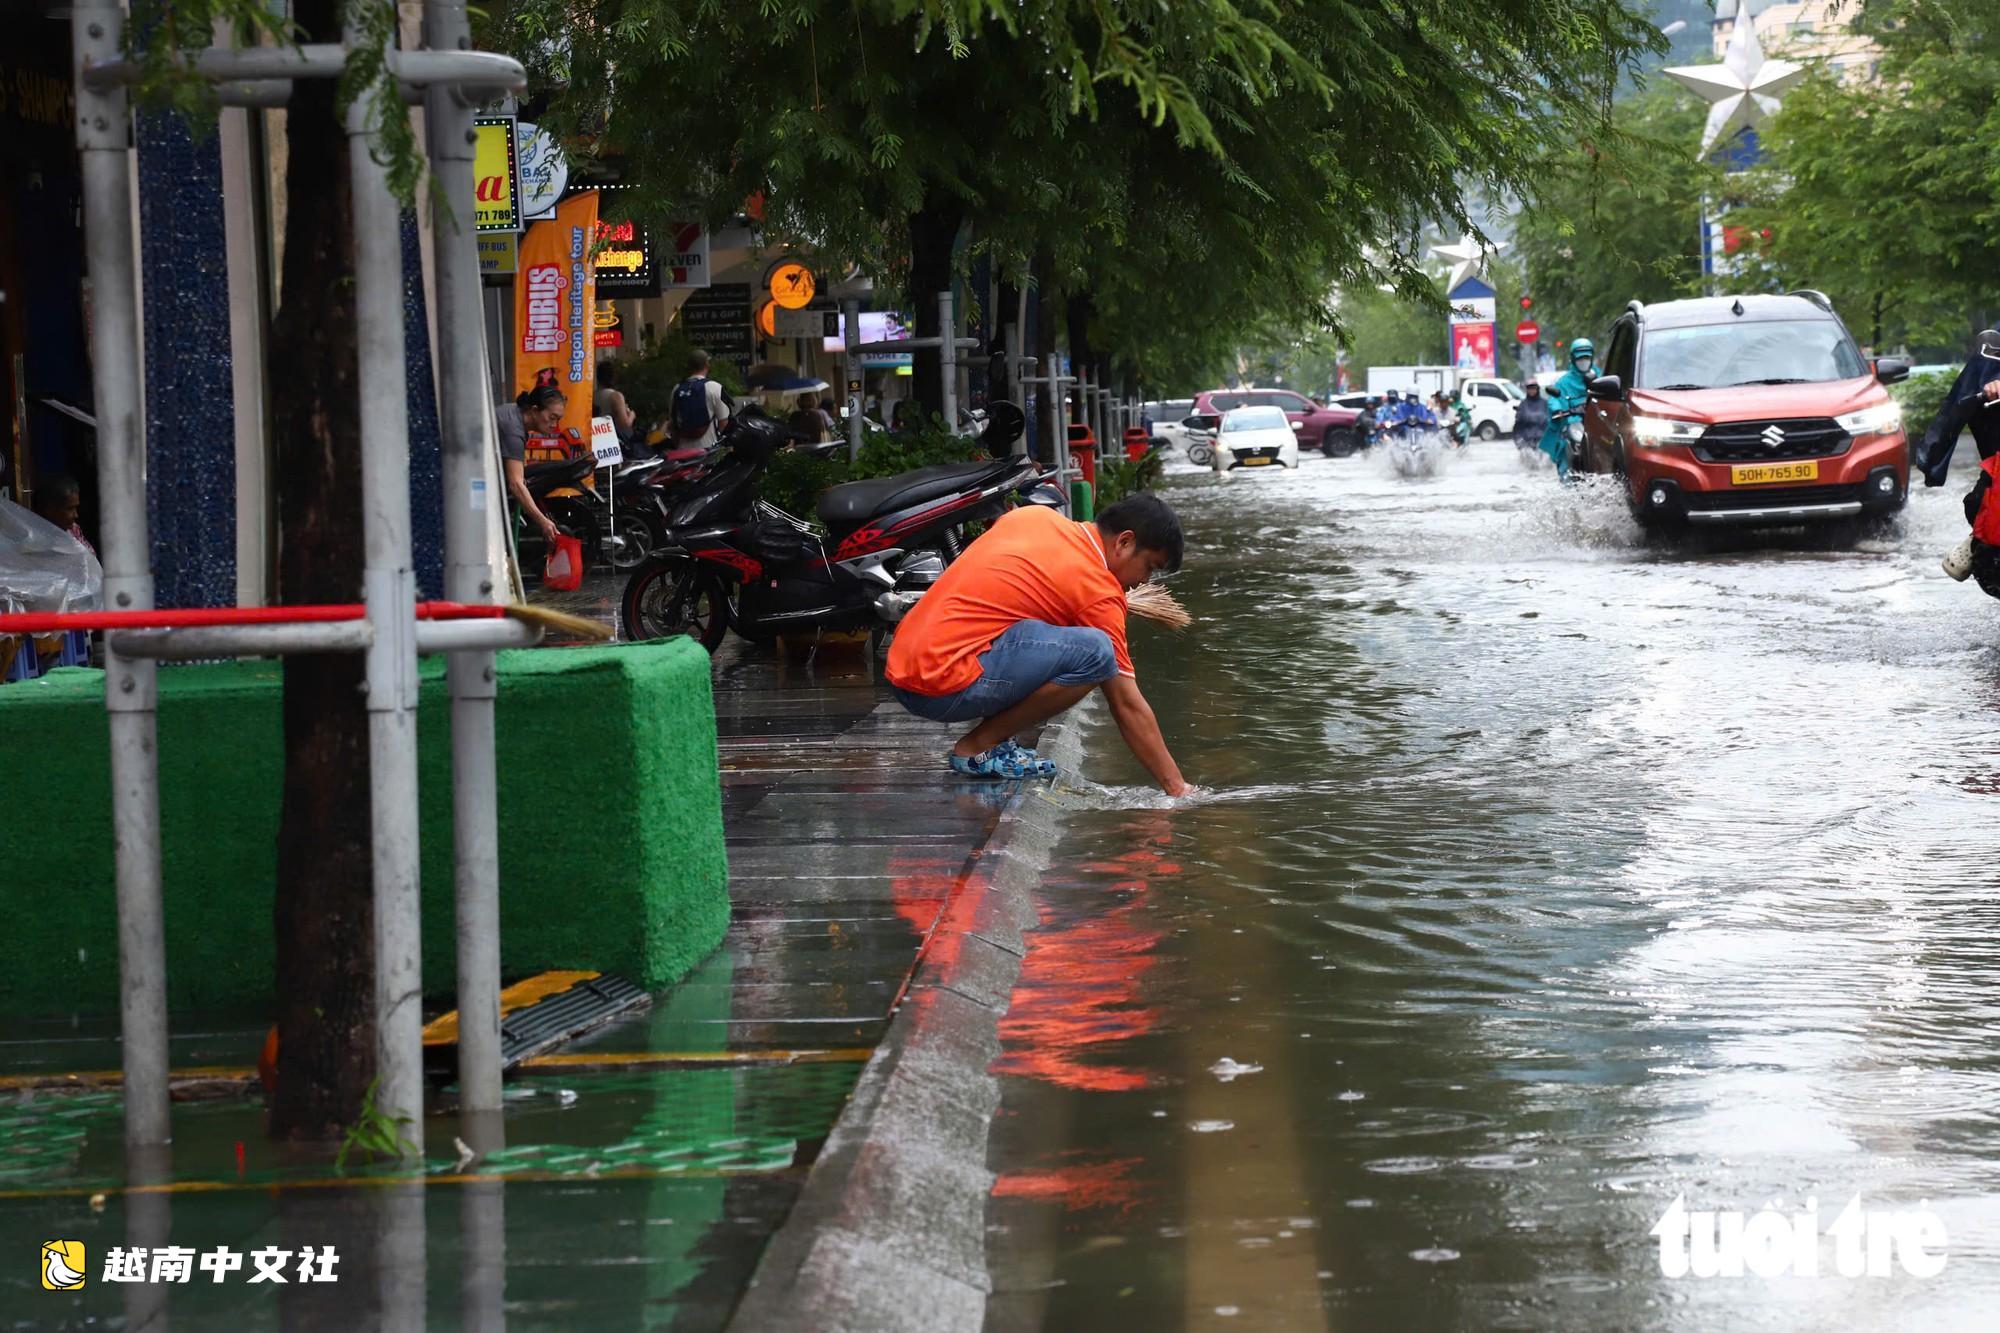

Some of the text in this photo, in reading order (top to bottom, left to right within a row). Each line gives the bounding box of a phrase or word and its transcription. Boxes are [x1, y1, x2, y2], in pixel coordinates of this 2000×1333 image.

[492, 210, 511, 220] 789
[491, 242, 507, 251] BUS
[571, 227, 585, 382] Saigon Heritage tour
[720, 310, 743, 319] GIFT
[597, 446, 620, 460] CARD
